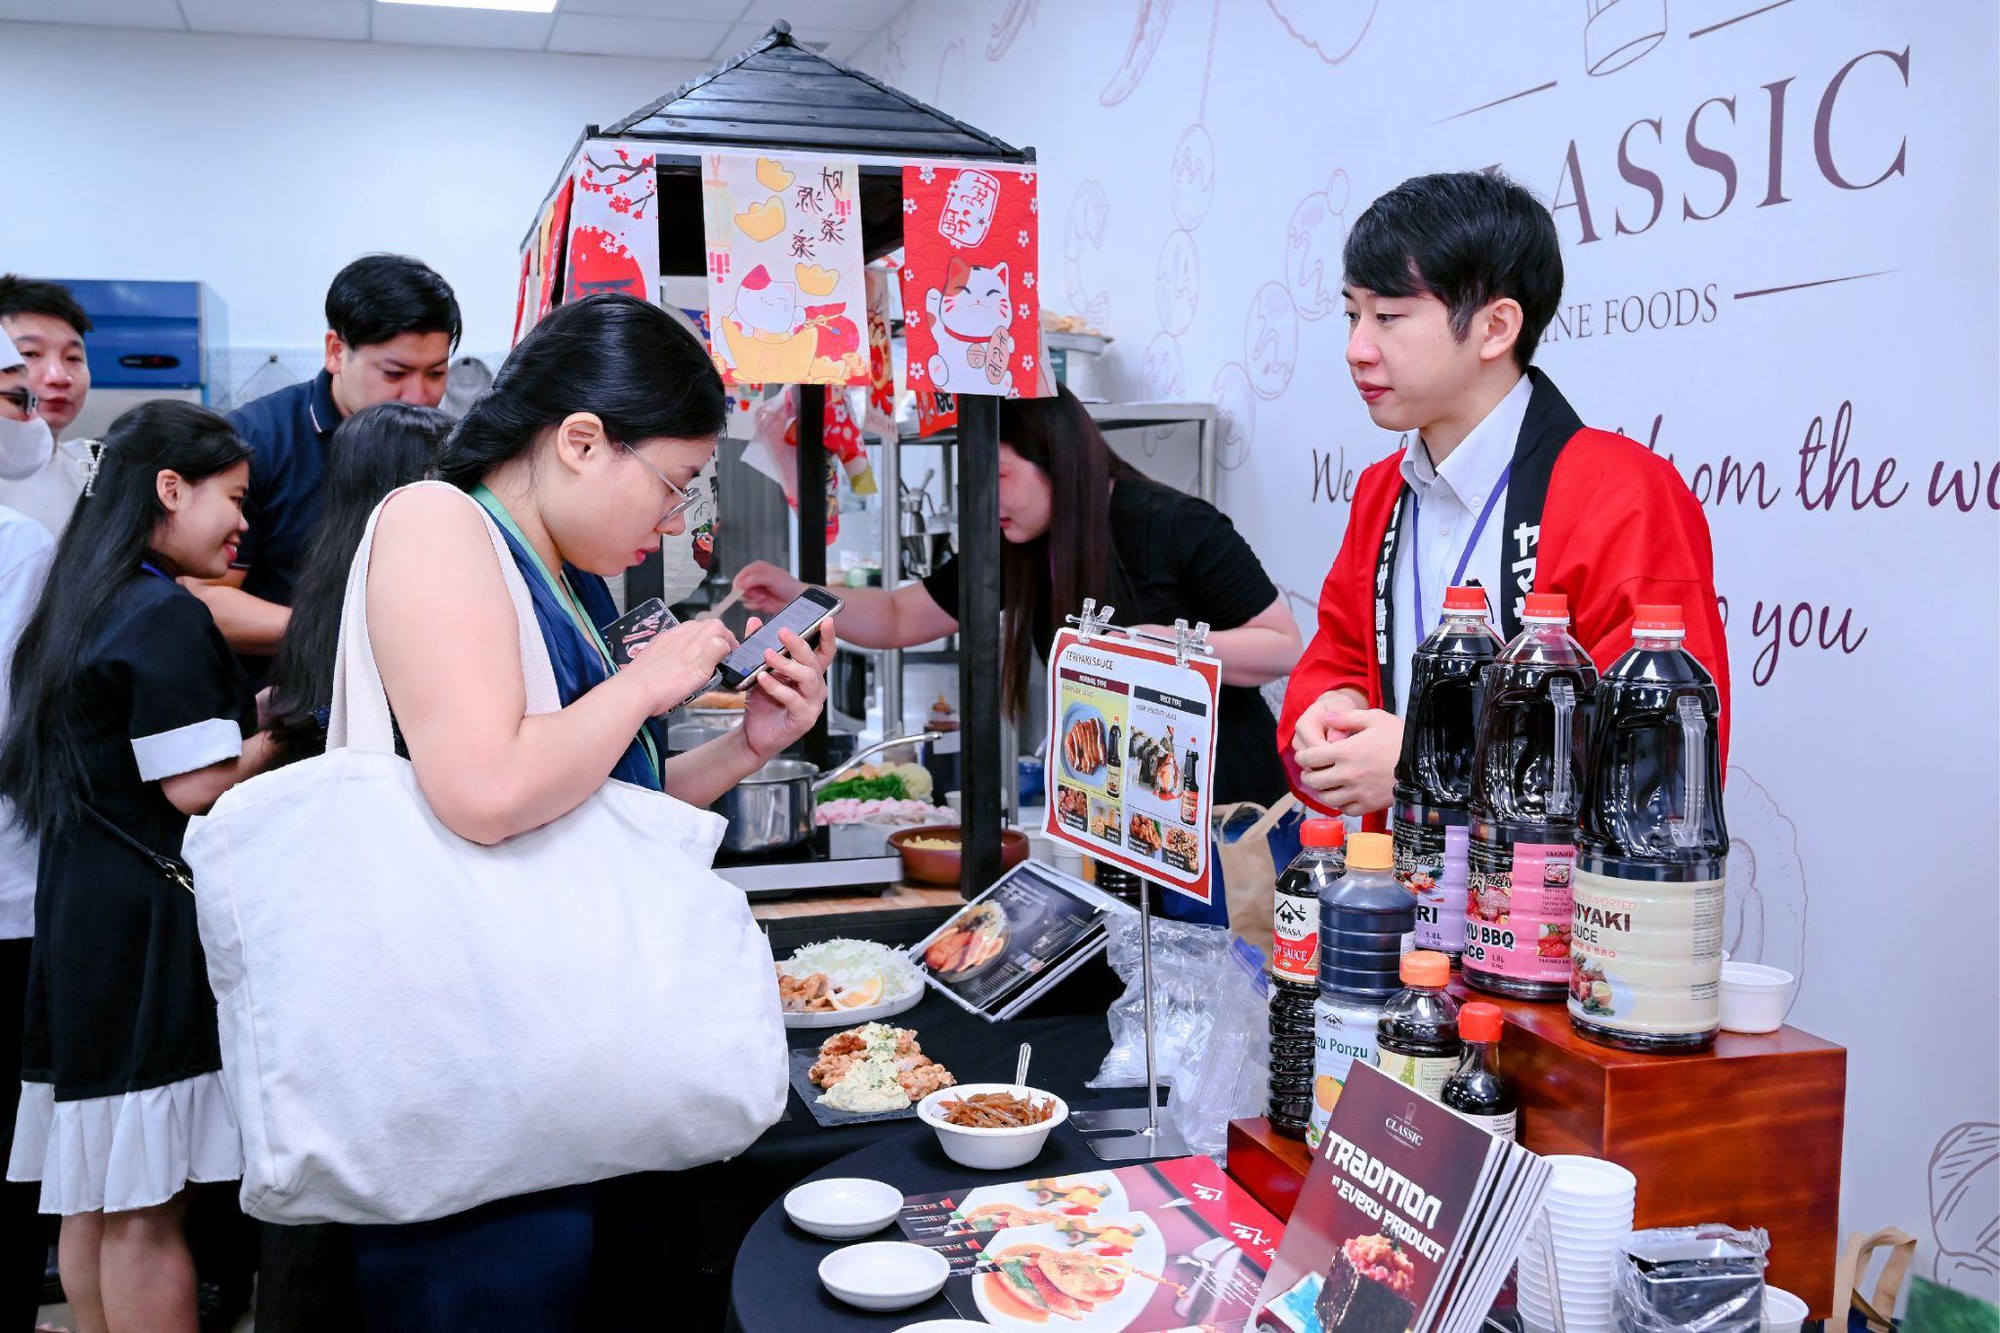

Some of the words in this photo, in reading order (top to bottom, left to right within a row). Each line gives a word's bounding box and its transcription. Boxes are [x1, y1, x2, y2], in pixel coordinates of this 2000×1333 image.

[1480, 45, 1910, 245] ASSIC
[1542, 304, 1593, 343] INE
[1603, 283, 1718, 335] FOODS
[1312, 446, 1354, 503] We
[1795, 400, 1910, 511] the
[1751, 600, 1868, 687] you
[1065, 650, 1092, 666] TERIYAKI
[1092, 656, 1114, 671] SAUCE
[1417, 905, 1438, 924] RI
[1573, 901, 1631, 932] IYAKI
[1481, 927, 1514, 950] BBQ
[1594, 947, 1617, 958] BBQ
[1283, 946, 1308, 962] SAUCE
[1329, 1038, 1368, 1059] Ponzu
[1385, 1117, 1424, 1146] CLASSIC
[1381, 1208, 1446, 1264] PRODUCT
